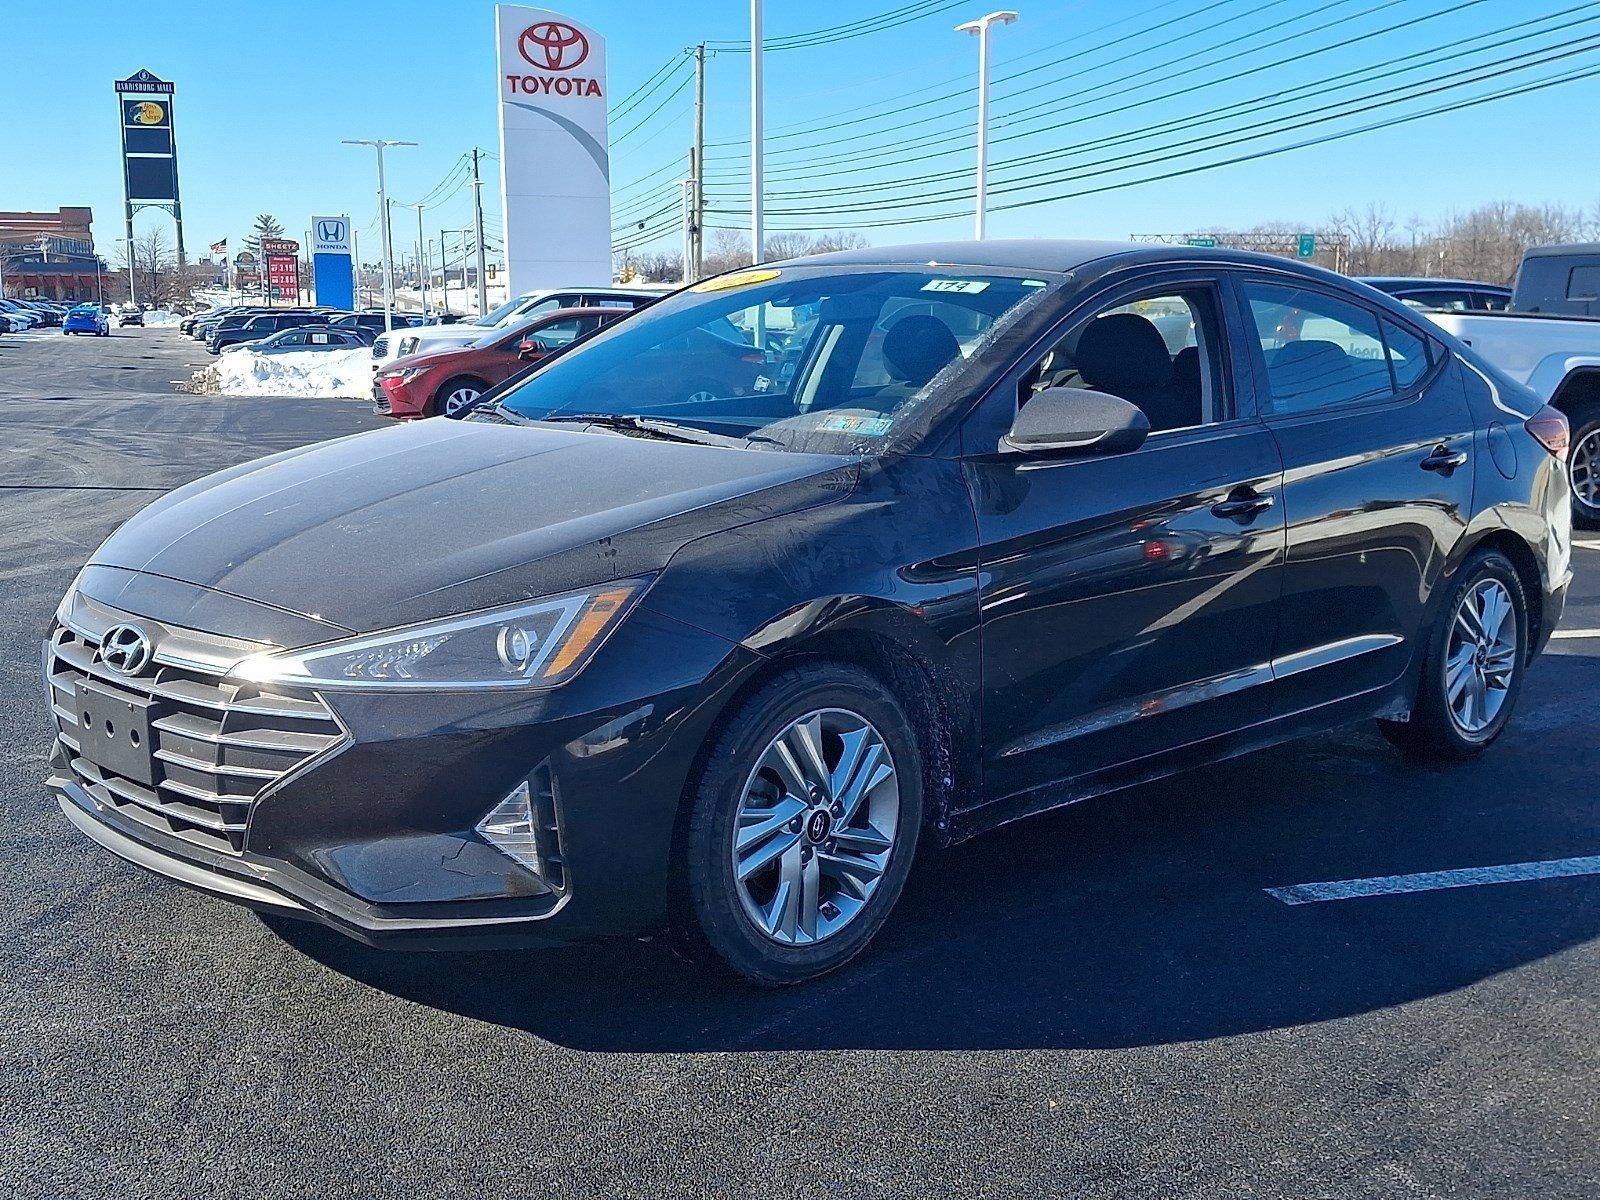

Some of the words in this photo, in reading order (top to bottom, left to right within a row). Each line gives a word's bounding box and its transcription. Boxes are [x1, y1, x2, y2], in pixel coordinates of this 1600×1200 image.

[116, 82, 155, 92] HARRISBURG
[156, 83, 173, 92] MALL
[506, 75, 603, 97] TOYOTA
